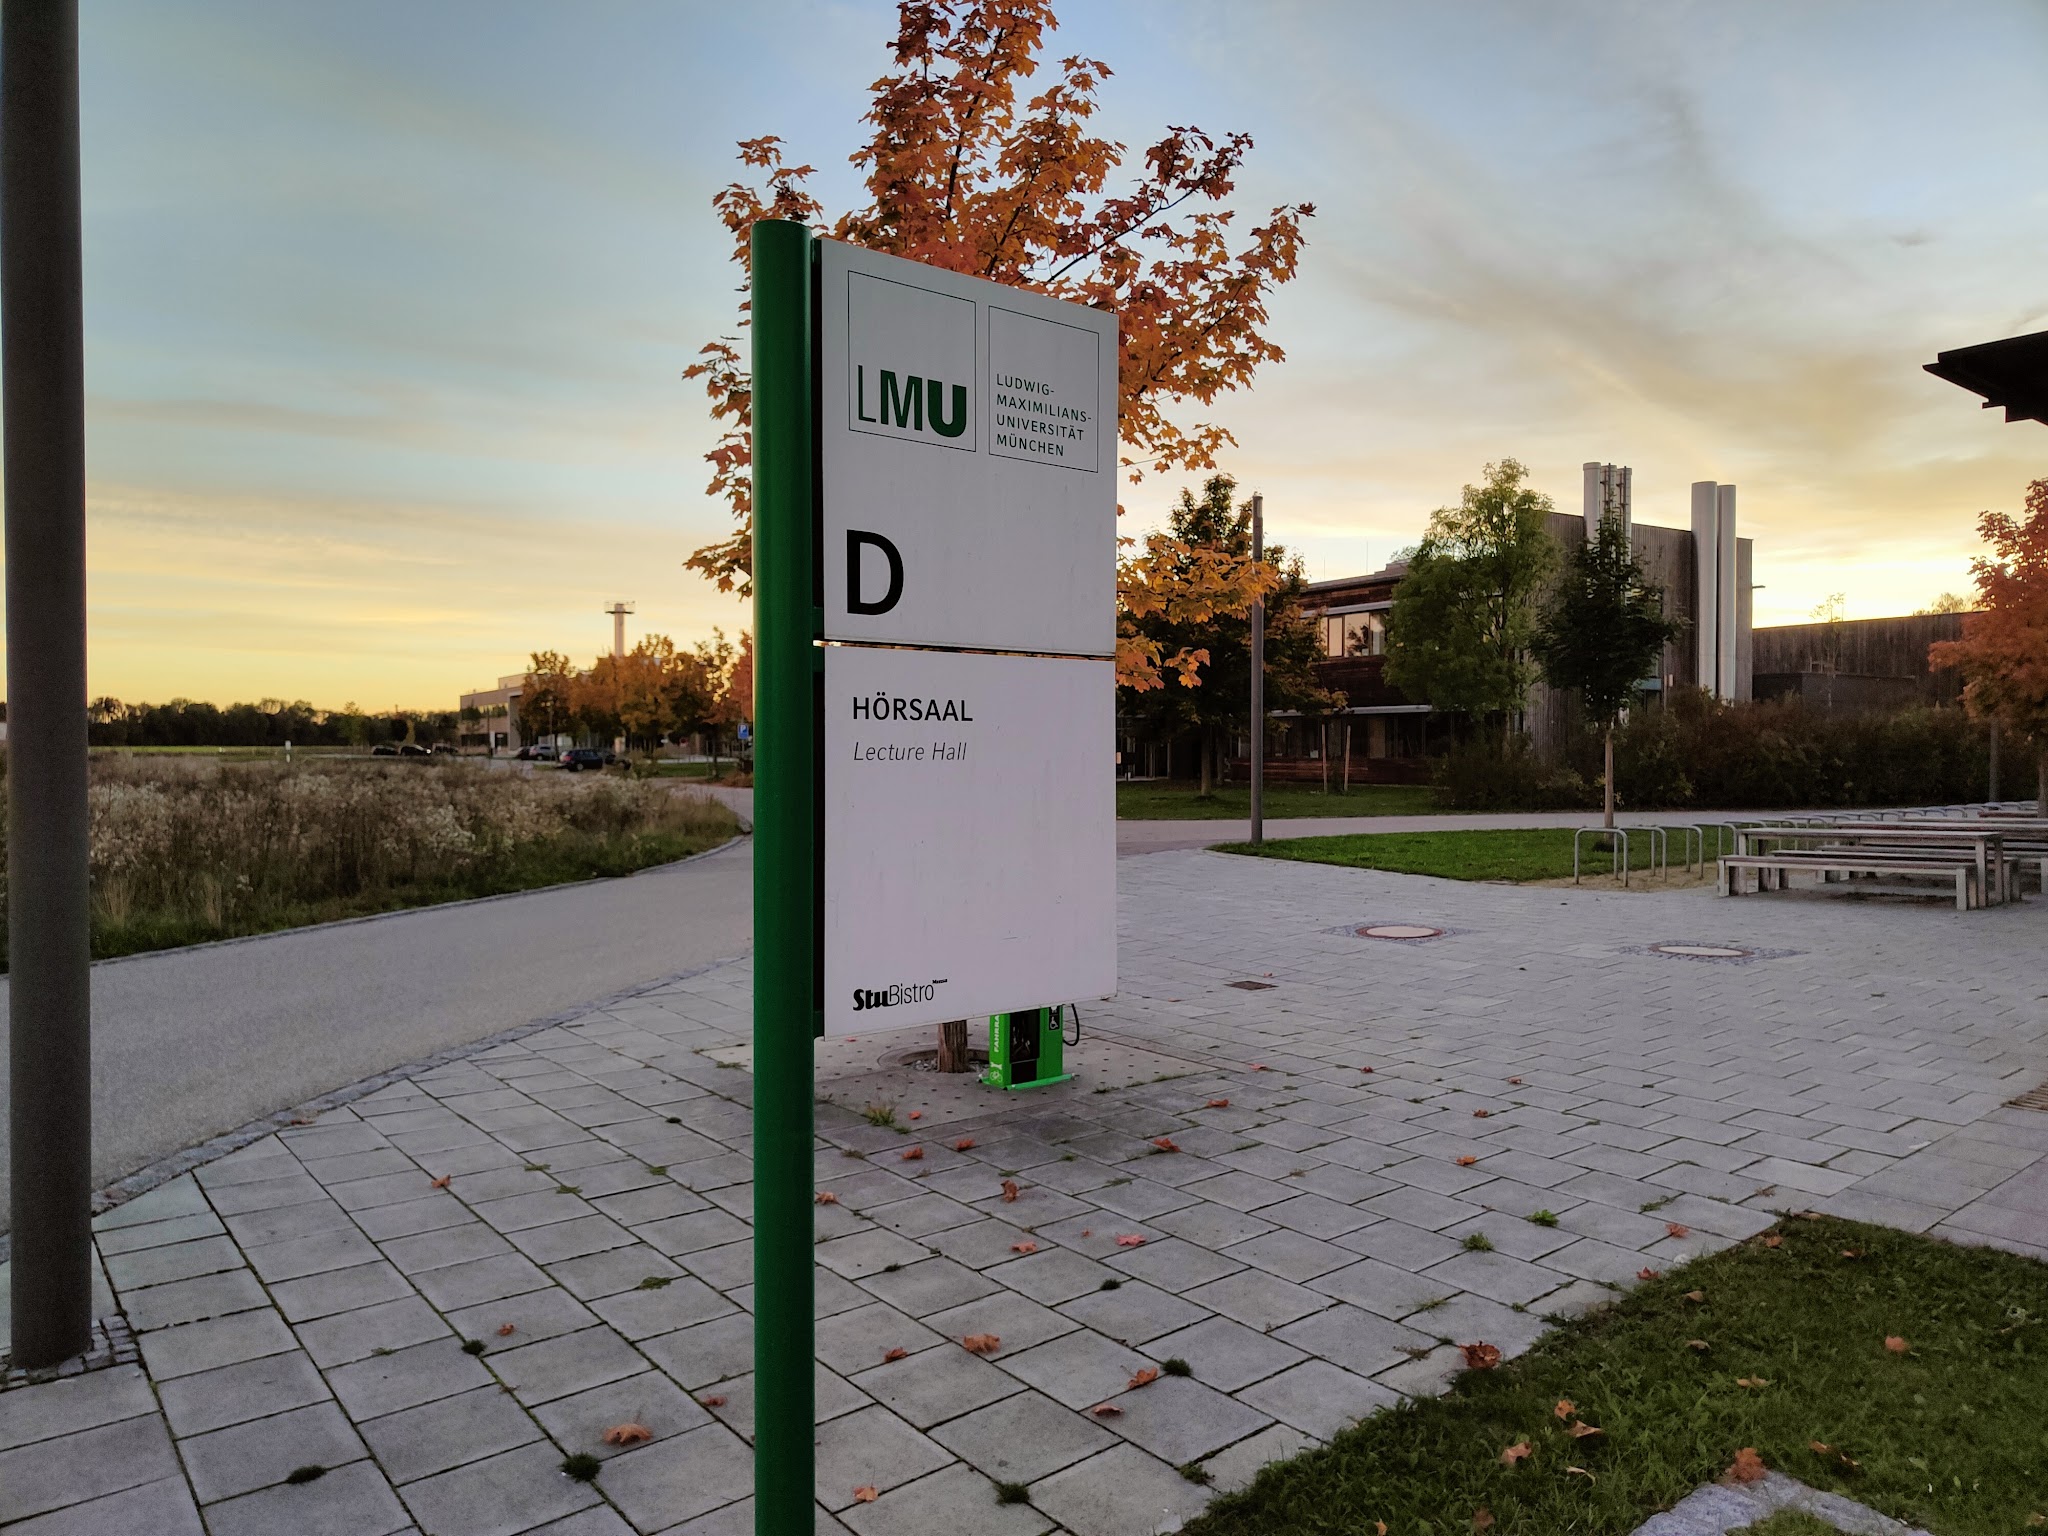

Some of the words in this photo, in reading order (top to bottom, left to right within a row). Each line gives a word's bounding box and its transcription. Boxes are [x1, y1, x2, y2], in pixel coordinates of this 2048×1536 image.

[996, 373, 1055, 396] LUDWIG-
[857, 364, 968, 438] LMU
[996, 393, 1092, 423] MAXIMILIANS-
[996, 413, 1085, 441] UNIVERSITÄT
[996, 432, 1064, 457] MÜNCHEN
[846, 529, 904, 616] D
[853, 691, 974, 722] HÖRSAAL
[853, 741, 925, 761] Lecture
[932, 741, 967, 761] Hall
